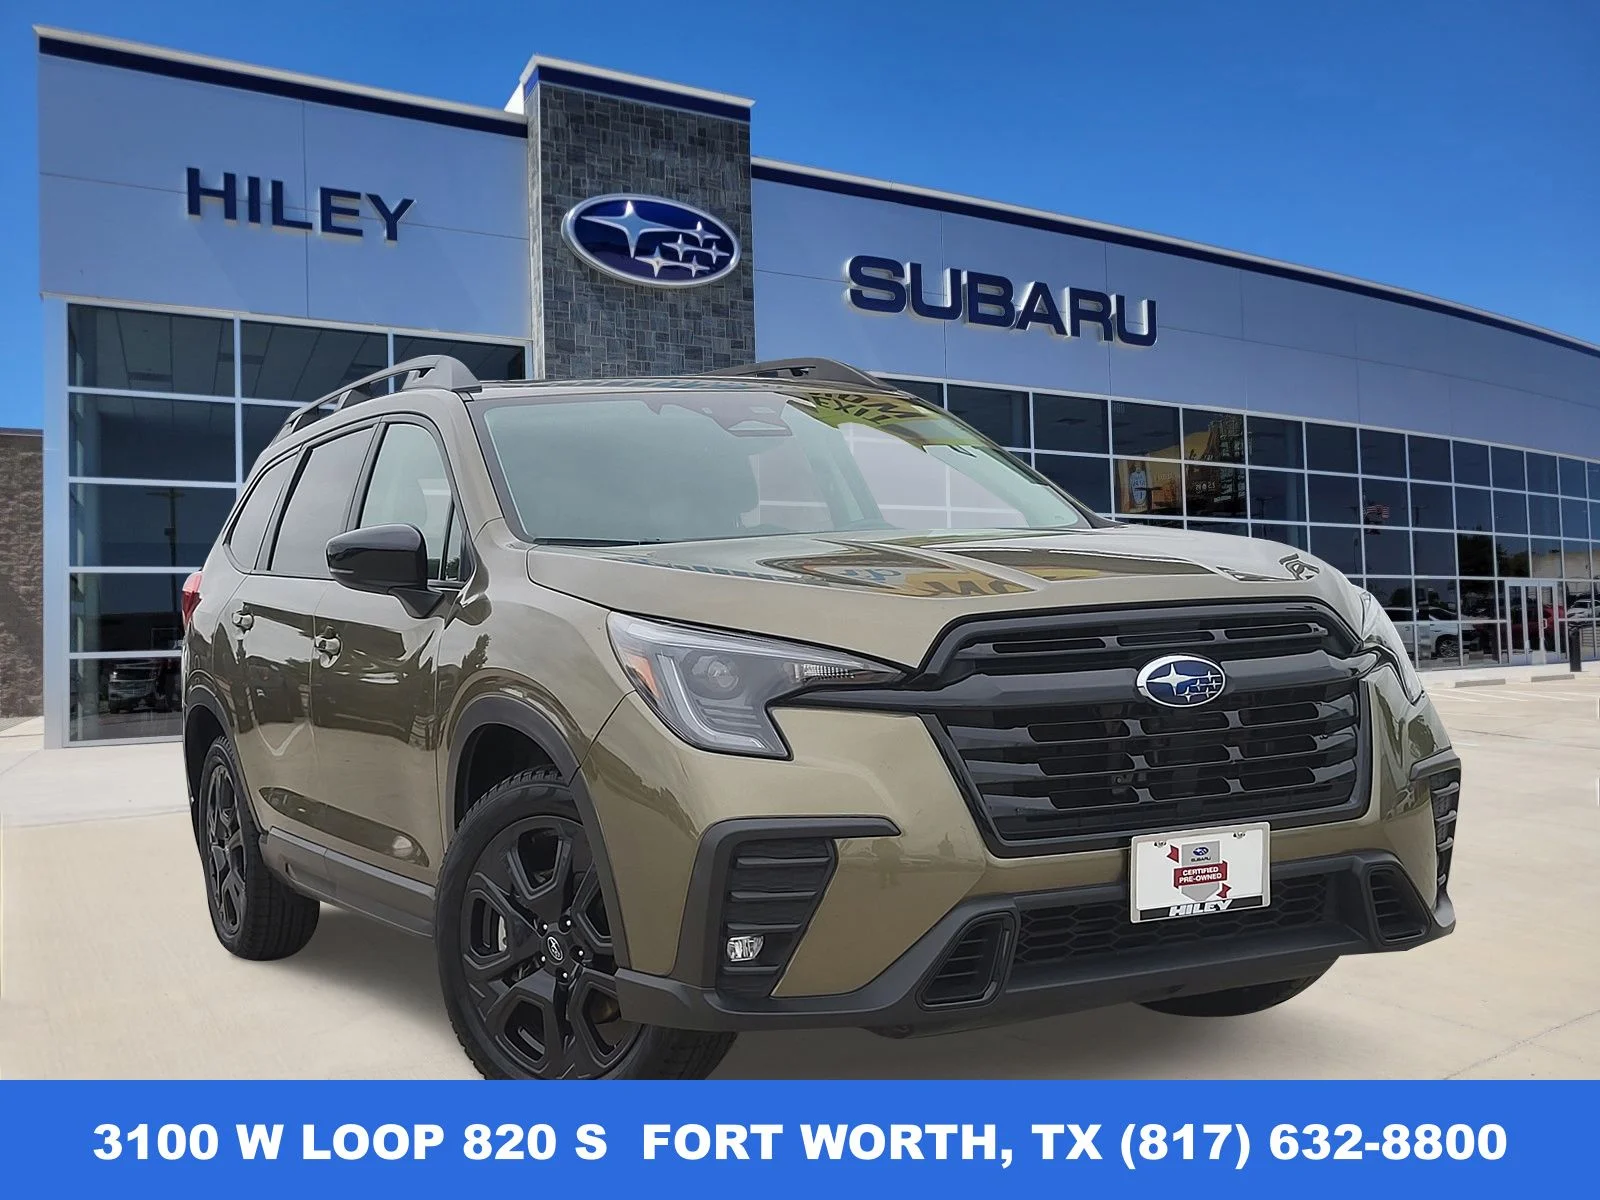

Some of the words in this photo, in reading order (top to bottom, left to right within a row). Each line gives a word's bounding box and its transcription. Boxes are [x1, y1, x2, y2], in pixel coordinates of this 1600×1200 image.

[187, 167, 414, 241] HILEY
[846, 254, 1158, 347] SUBARU
[1179, 873, 1222, 884] PRE-OWNED
[1182, 867, 1219, 876] CERTIFIED
[1169, 899, 1233, 917] HILEY
